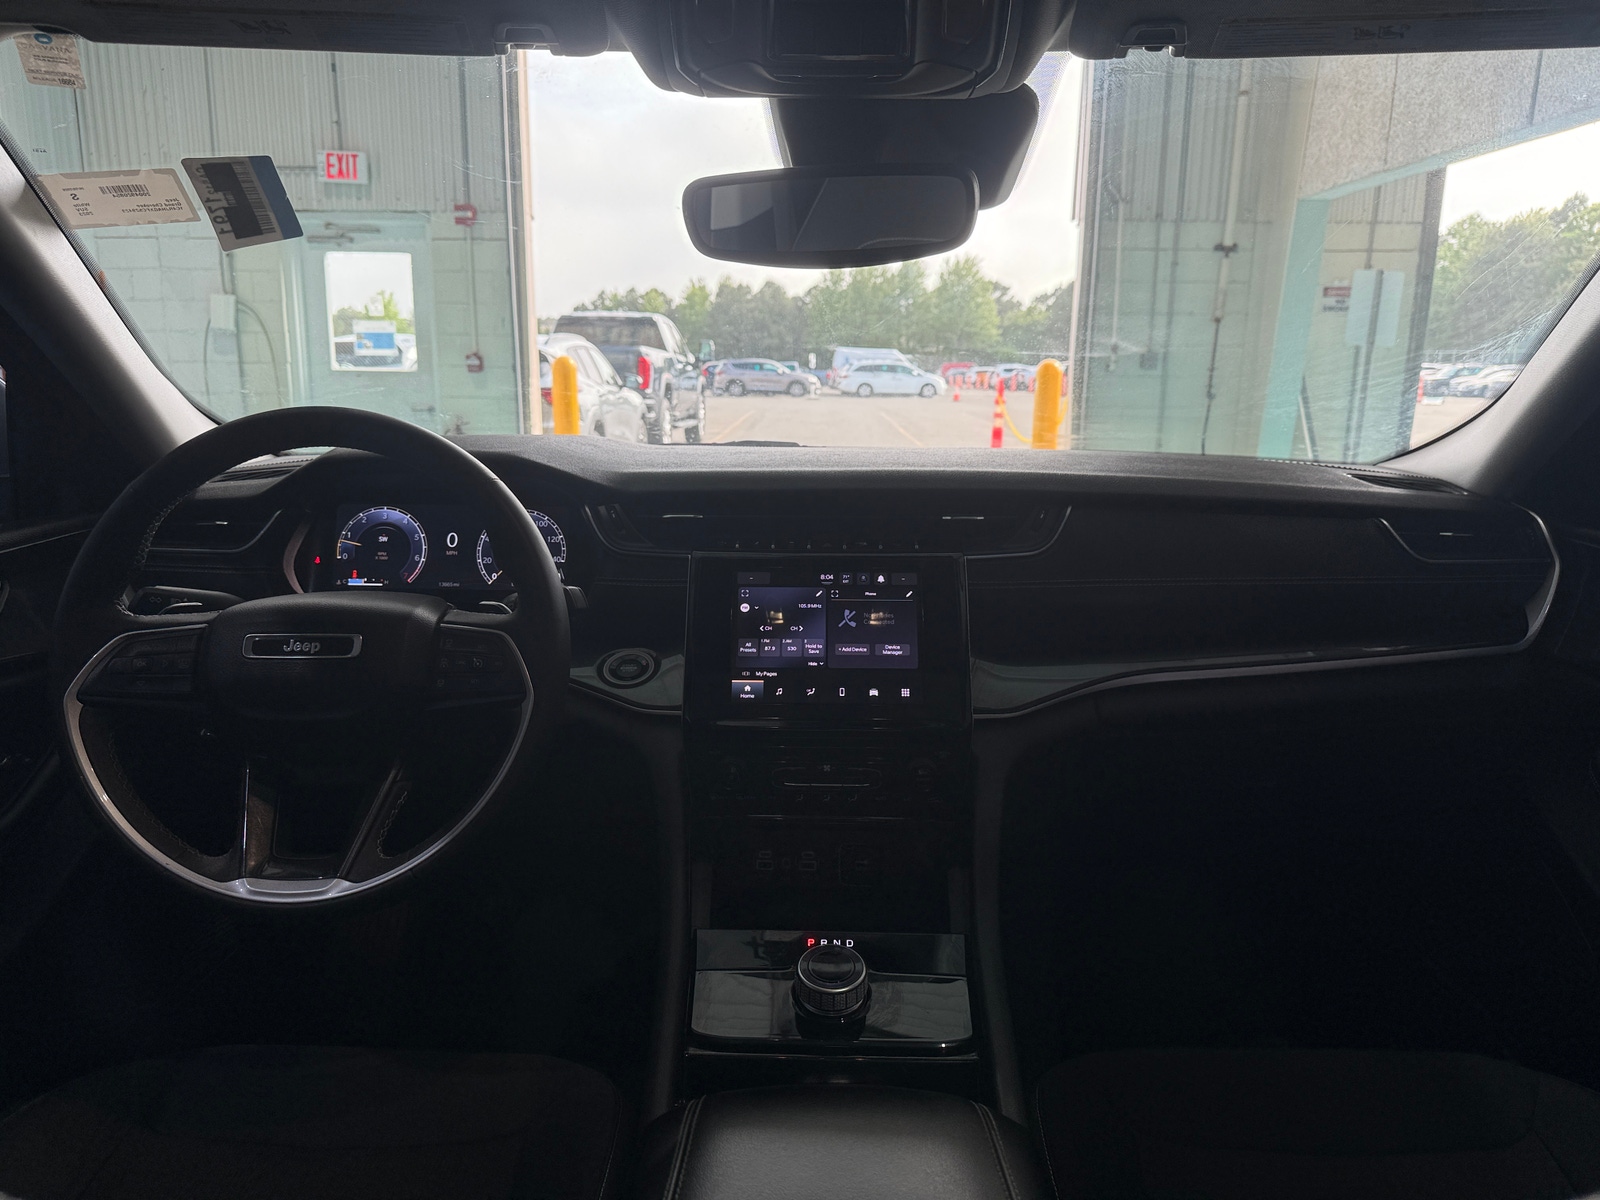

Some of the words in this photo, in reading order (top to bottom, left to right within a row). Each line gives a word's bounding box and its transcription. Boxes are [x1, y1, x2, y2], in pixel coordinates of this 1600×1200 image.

[325, 152, 359, 180] EXIT
[382, 512, 388, 520] 3
[534, 520, 548, 528] 100
[446, 532, 459, 548] 0
[547, 535, 560, 543] 120
[414, 554, 420, 562] 6
[282, 639, 321, 654] Jeep
[807, 938, 816, 947] P
[846, 939, 854, 948] D
